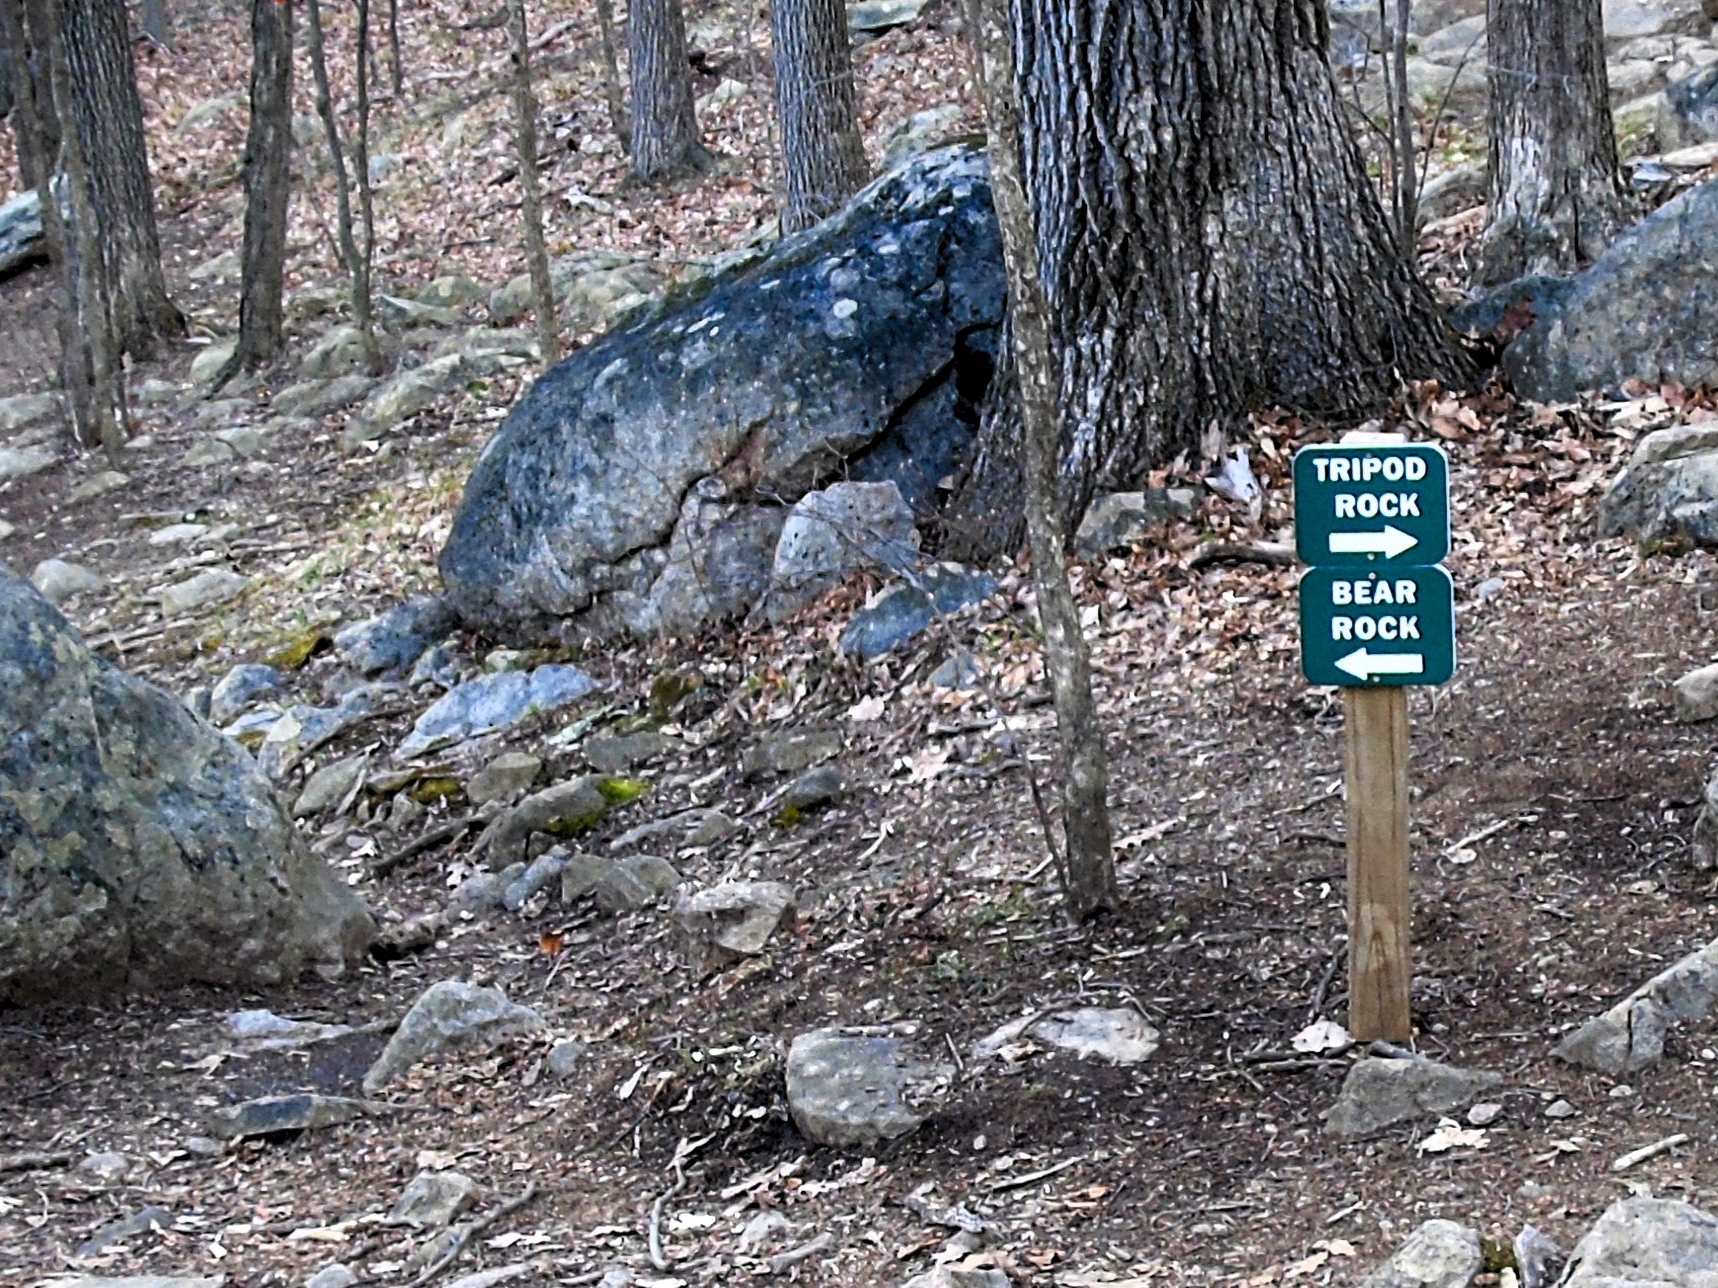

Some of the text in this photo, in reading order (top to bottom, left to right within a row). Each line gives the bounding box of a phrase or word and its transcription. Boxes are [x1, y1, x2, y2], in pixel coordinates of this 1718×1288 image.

[1312, 456, 1427, 482] TRIPOD
[1334, 492, 1421, 518] ROCK
[1332, 579, 1418, 605] BEAR
[1331, 615, 1421, 641] ROCK
